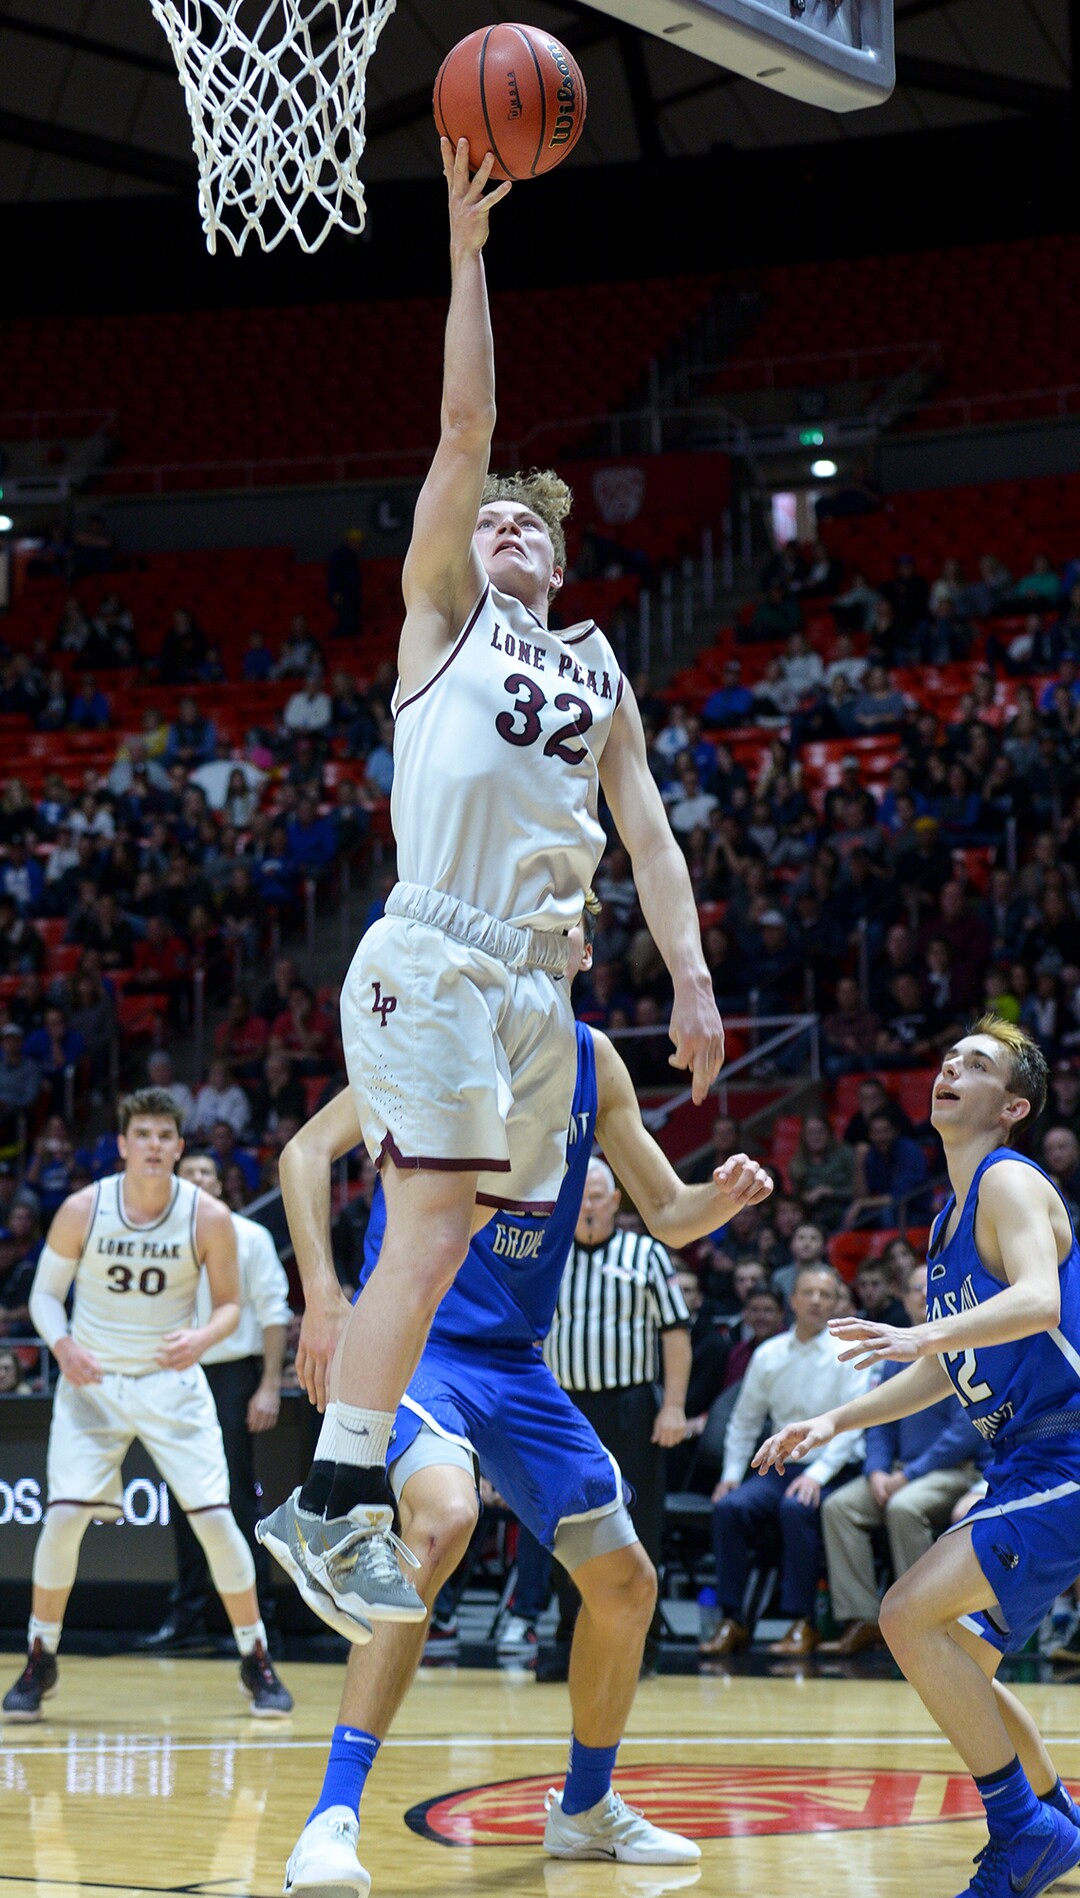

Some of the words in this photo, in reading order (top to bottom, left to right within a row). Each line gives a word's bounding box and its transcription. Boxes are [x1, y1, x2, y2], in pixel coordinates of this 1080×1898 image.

[546, 42, 575, 149] Wilson
[378, 500, 401, 528] L
[490, 622, 547, 671] LONE
[495, 673, 593, 765] 32
[371, 981, 398, 1028] LP
[97, 1237, 135, 1257] LONE
[142, 1241, 181, 1259] PEAK
[492, 1223, 545, 1259] GROVE
[107, 1264, 166, 1296] 30
